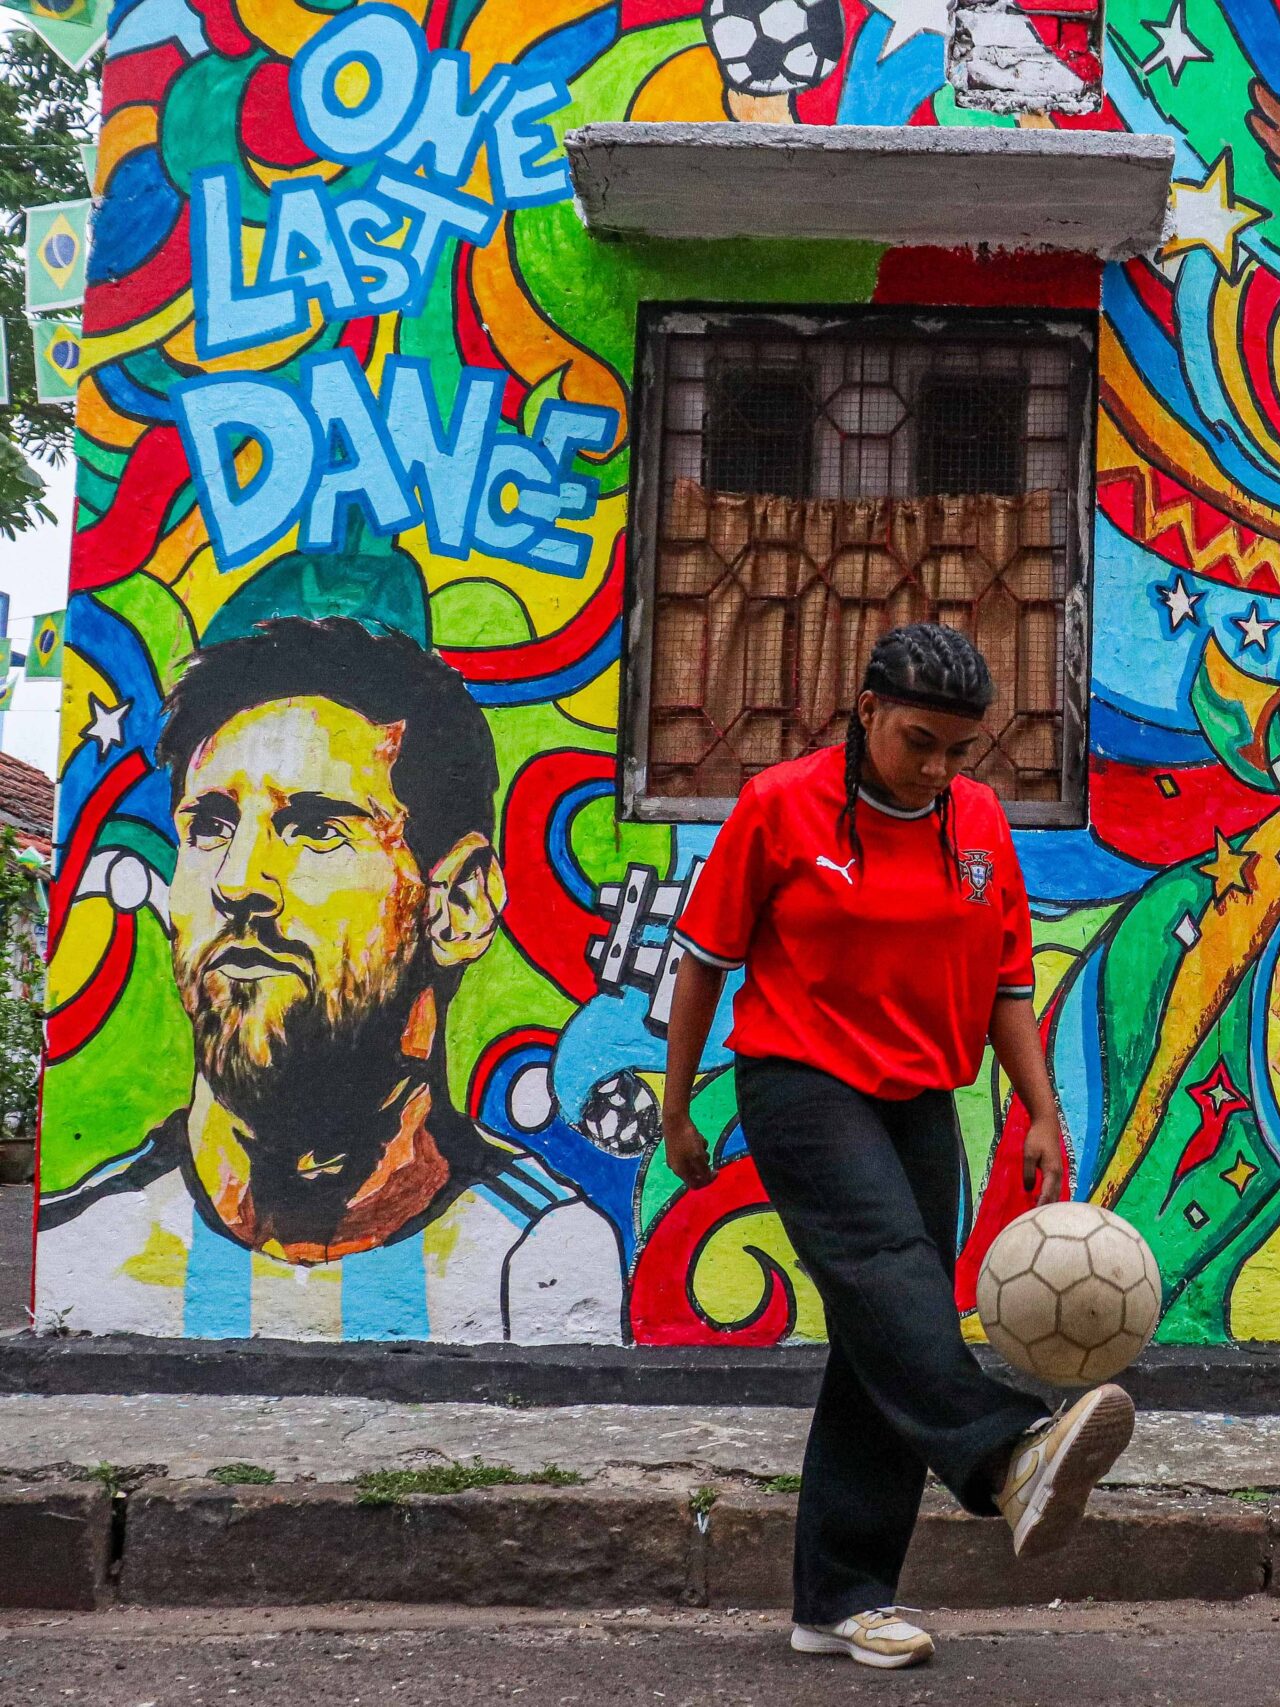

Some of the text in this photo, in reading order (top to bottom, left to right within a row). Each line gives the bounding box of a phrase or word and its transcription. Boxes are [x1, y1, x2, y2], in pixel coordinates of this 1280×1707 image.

[290, 2, 571, 207] ONE
[191, 164, 506, 360] LAST
[169, 348, 620, 578] DANCE
